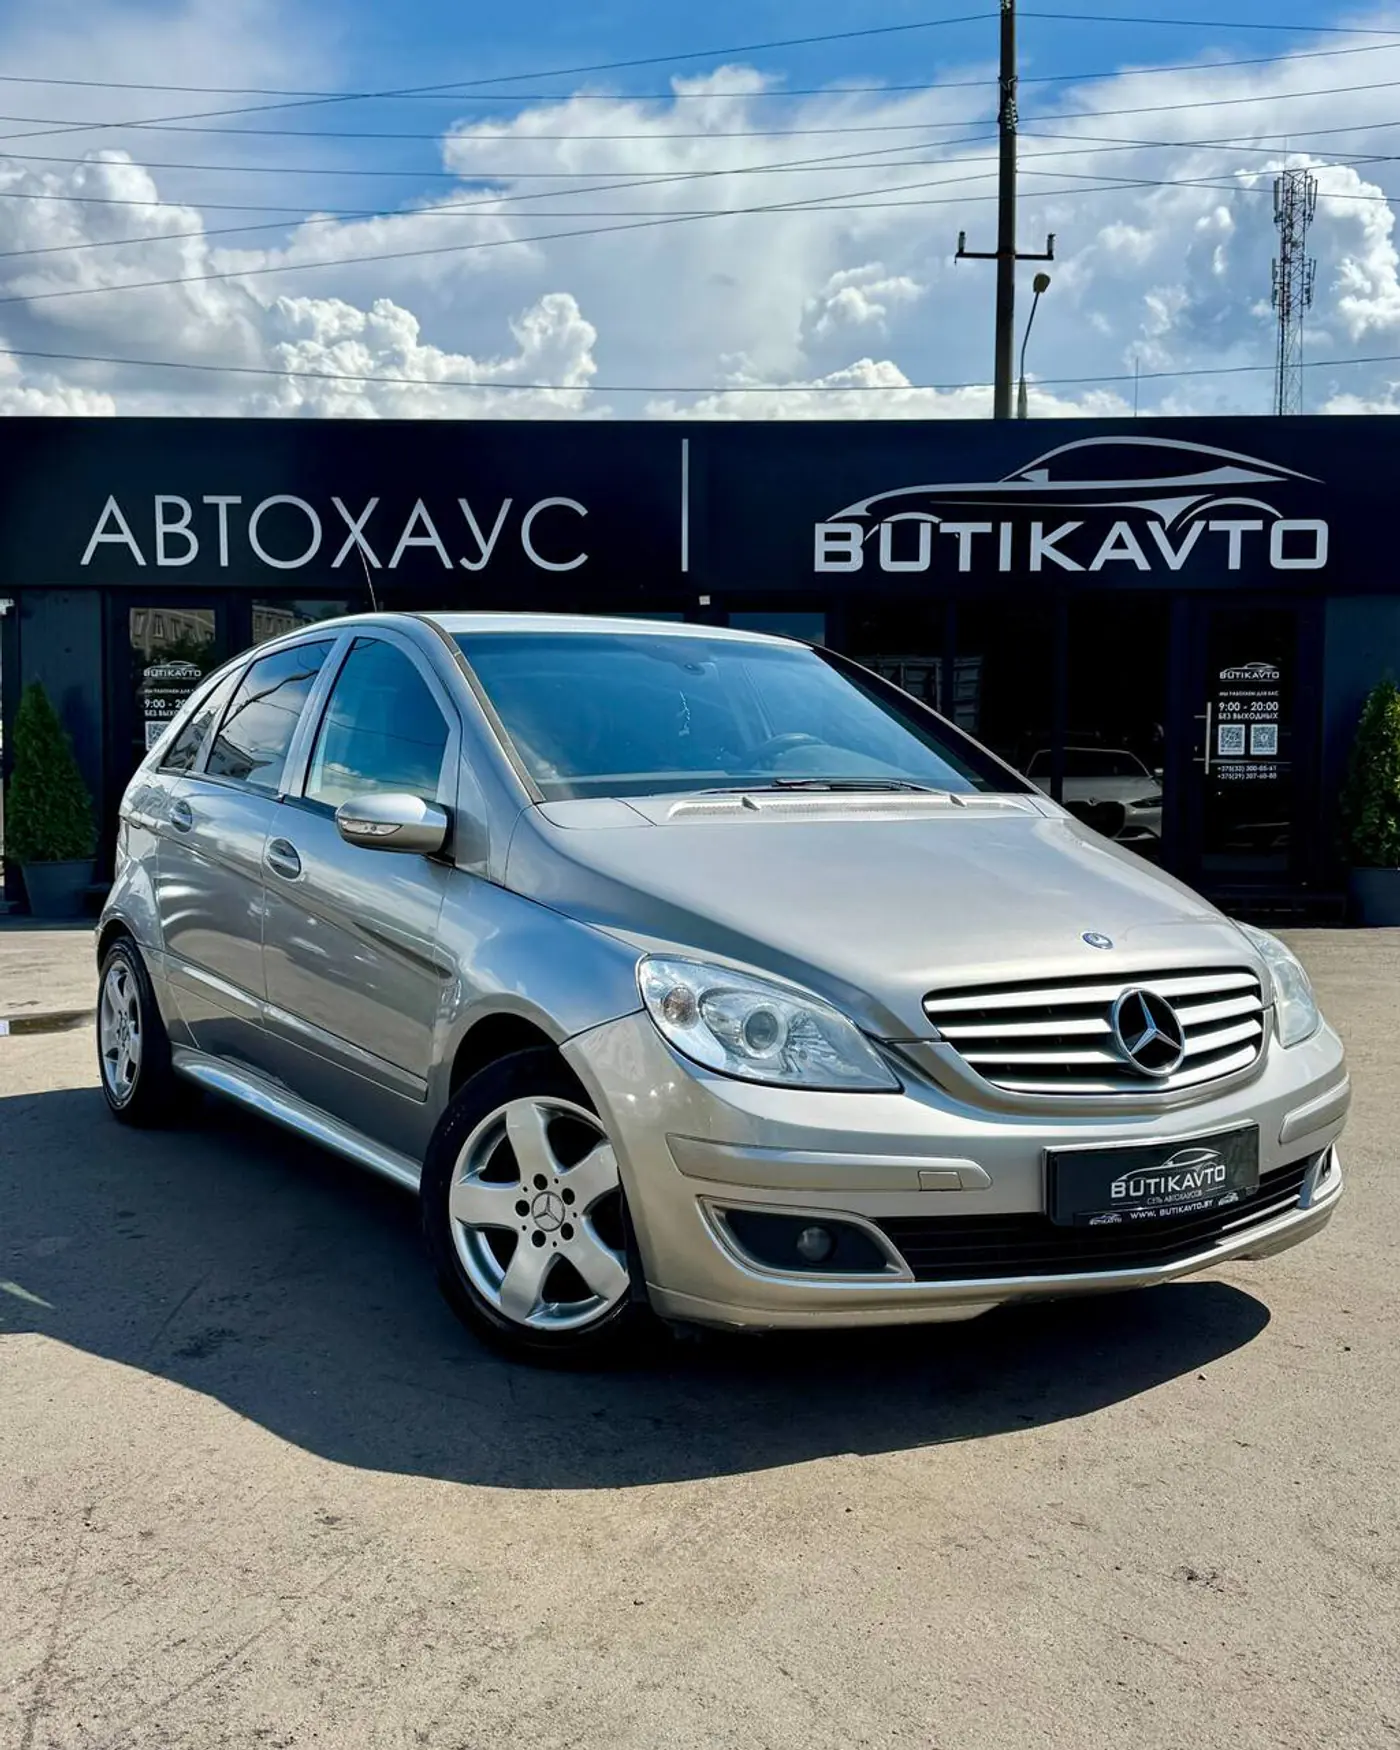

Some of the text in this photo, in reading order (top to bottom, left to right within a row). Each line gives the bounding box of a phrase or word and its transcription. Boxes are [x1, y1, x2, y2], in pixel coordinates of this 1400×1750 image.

[80, 494, 589, 572] АВТОХАУС
[813, 517, 1329, 573] BUTIKAVTO
[143, 669, 202, 677] BUTIKAVTO
[1219, 671, 1280, 679] BUTIKAVTO
[144, 699, 166, 708] 9:00
[1218, 701, 1241, 711] 9:00
[1250, 701, 1279, 711] 20:00
[1218, 712, 1278, 720] БЕЗ ВЫХОДНЫХ
[1110, 1165, 1226, 1199] BUTIKAVTO
